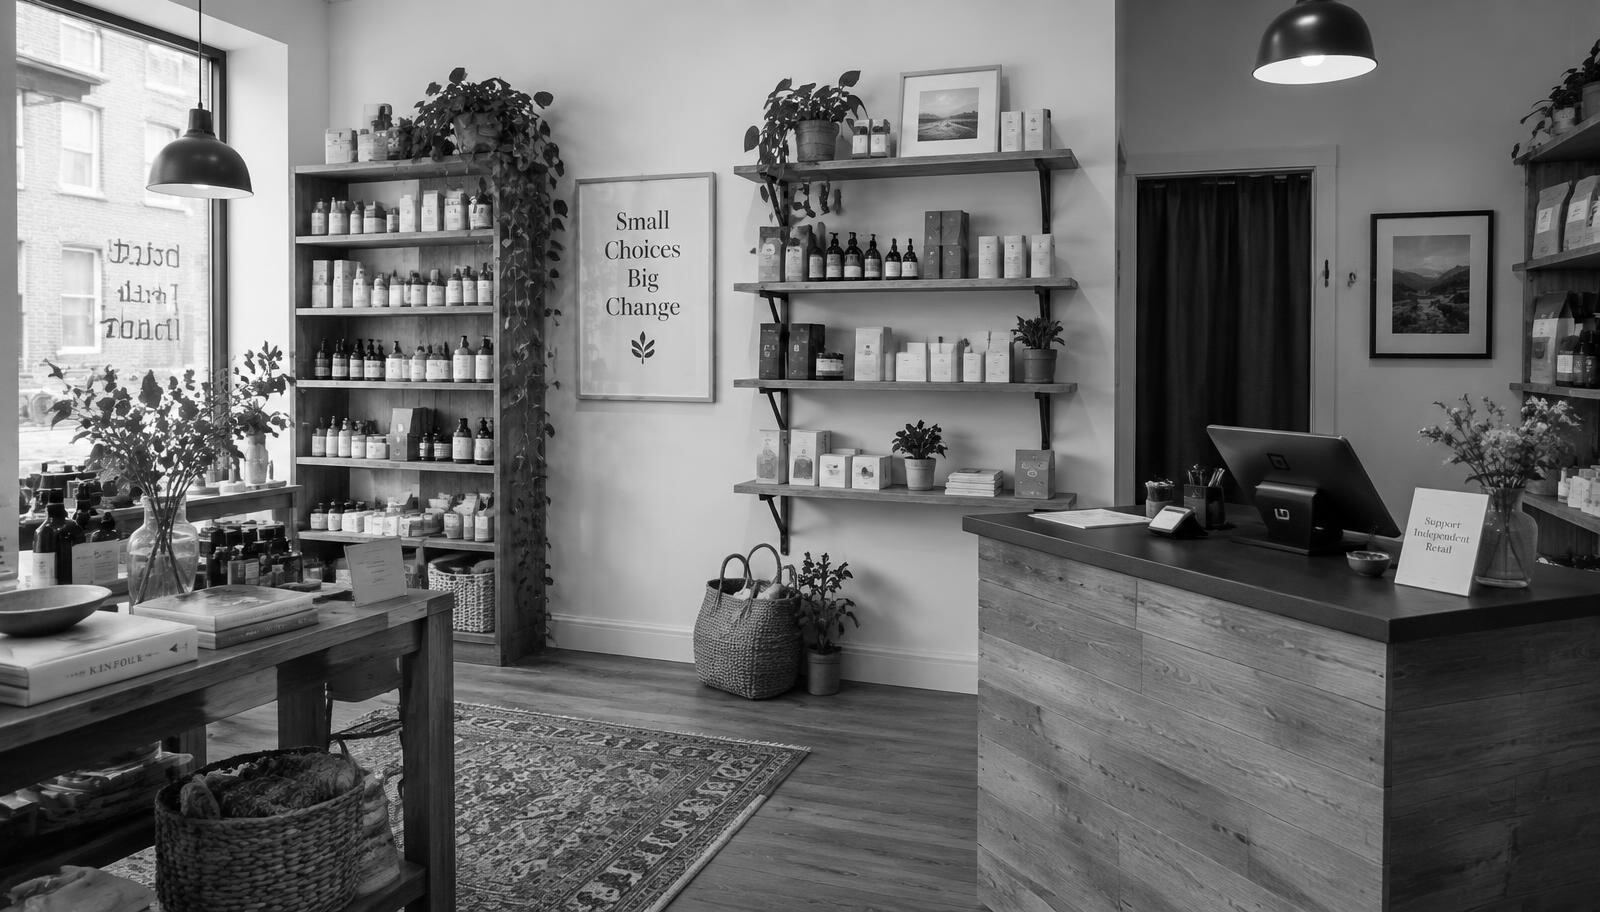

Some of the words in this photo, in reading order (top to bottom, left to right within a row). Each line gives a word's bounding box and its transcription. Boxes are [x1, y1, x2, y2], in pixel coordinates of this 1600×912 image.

[616, 209, 670, 231] Small
[604, 239, 681, 260] Choices
[627, 268, 659, 293] Big
[605, 296, 681, 322] Change
[1424, 516, 1462, 529] Support
[1413, 528, 1470, 544] Independent
[1425, 542, 1452, 554] Retail
